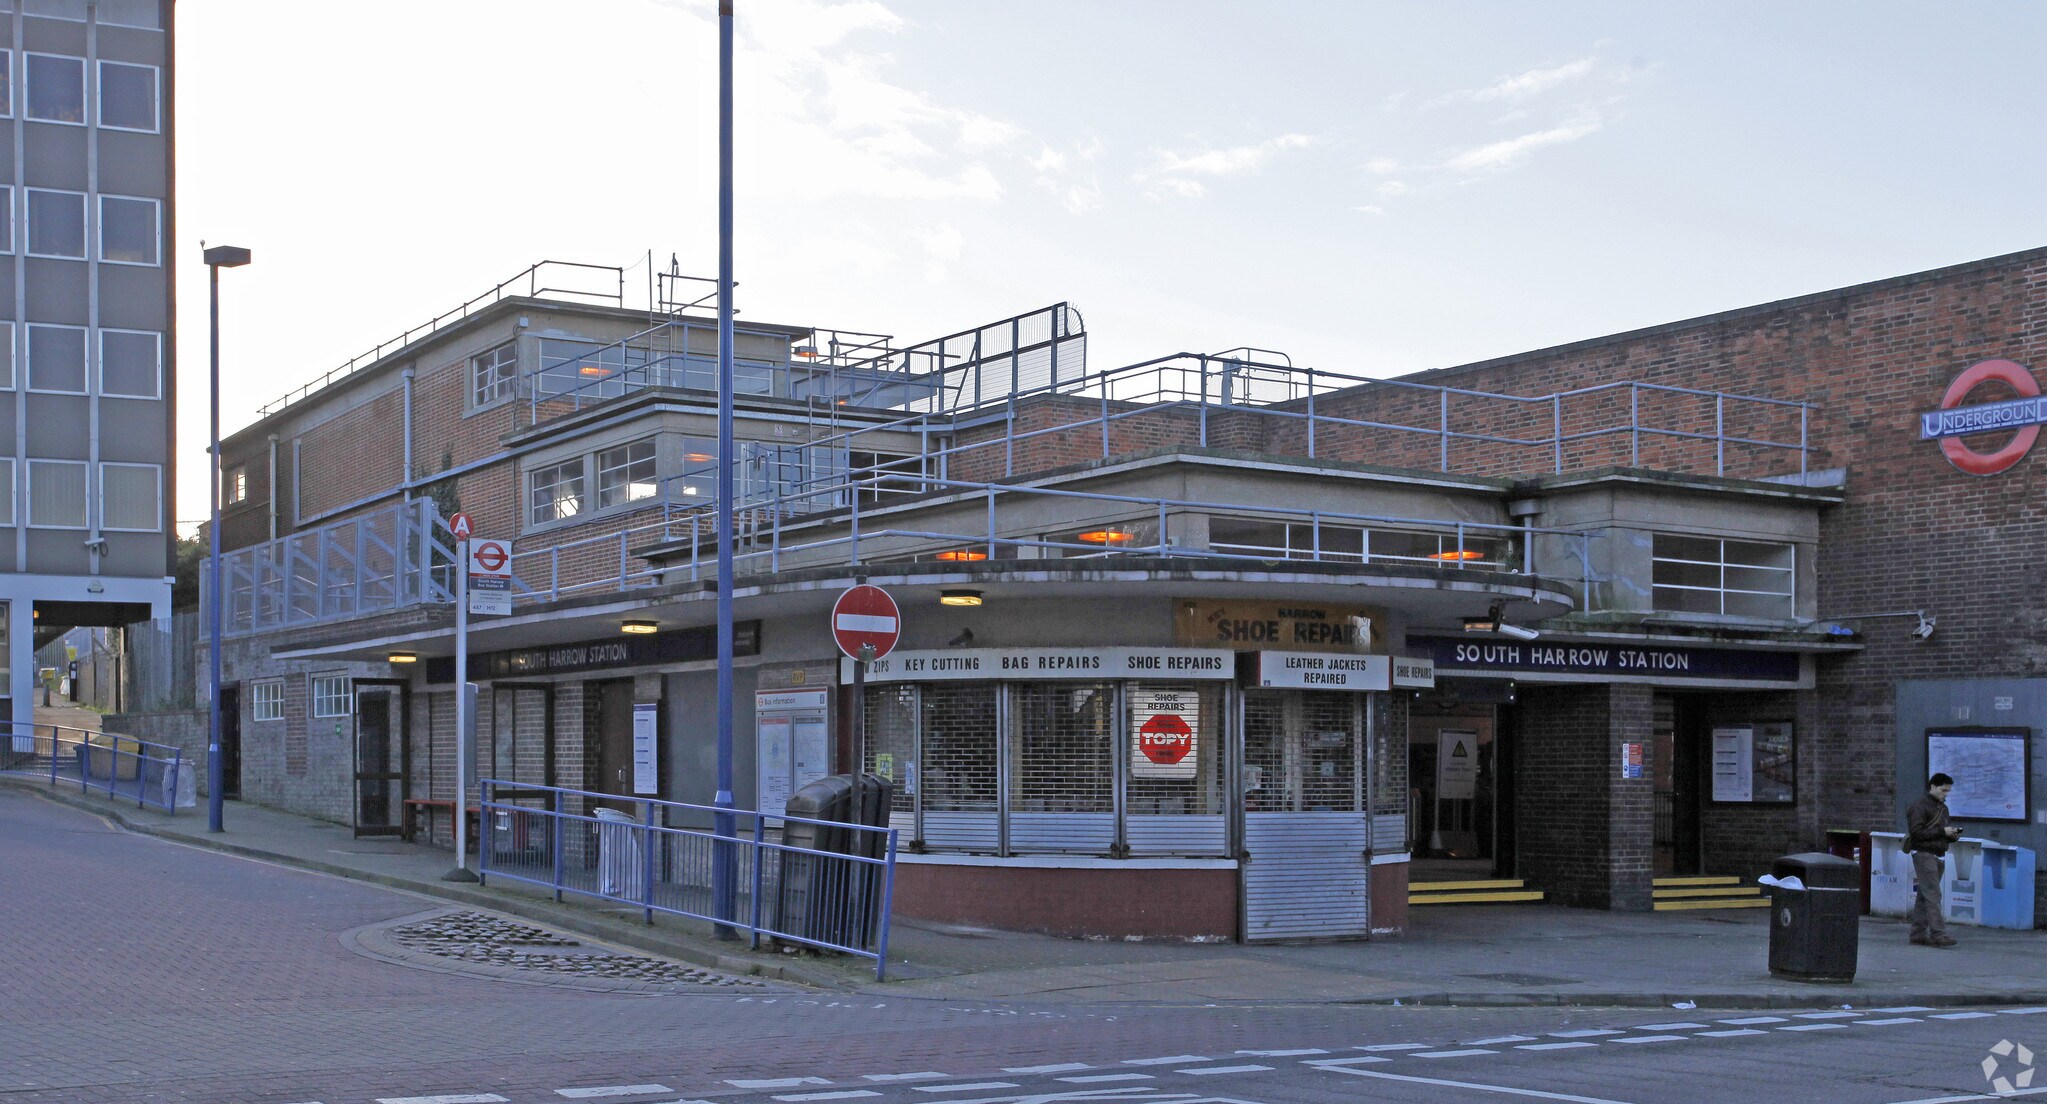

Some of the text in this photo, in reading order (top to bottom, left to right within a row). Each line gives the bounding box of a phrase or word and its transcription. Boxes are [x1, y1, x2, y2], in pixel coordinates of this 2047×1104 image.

[454, 516, 470, 534] A
[1217, 619, 1280, 642] SHOE
[519, 642, 628, 670] SOUTH HARROW STATION
[1002, 656, 1101, 670] BAG REPAIRS
[1127, 656, 1223, 671] SHOE REPAIRS
[1456, 643, 1689, 671] SOUTH HARROW STATION
[873, 660, 890, 673] ZIPS
[905, 657, 980, 671] KEY CUTTING
[1285, 657, 1367, 672] LEATHER JACKETS
[1303, 672, 1347, 685] REPAIRED
[1396, 664, 1433, 680] SHOE REPAIRS
[1154, 693, 1179, 702] SHOE
[1147, 702, 1186, 712] REPAIRS
[1141, 732, 1190, 747] TOPY
